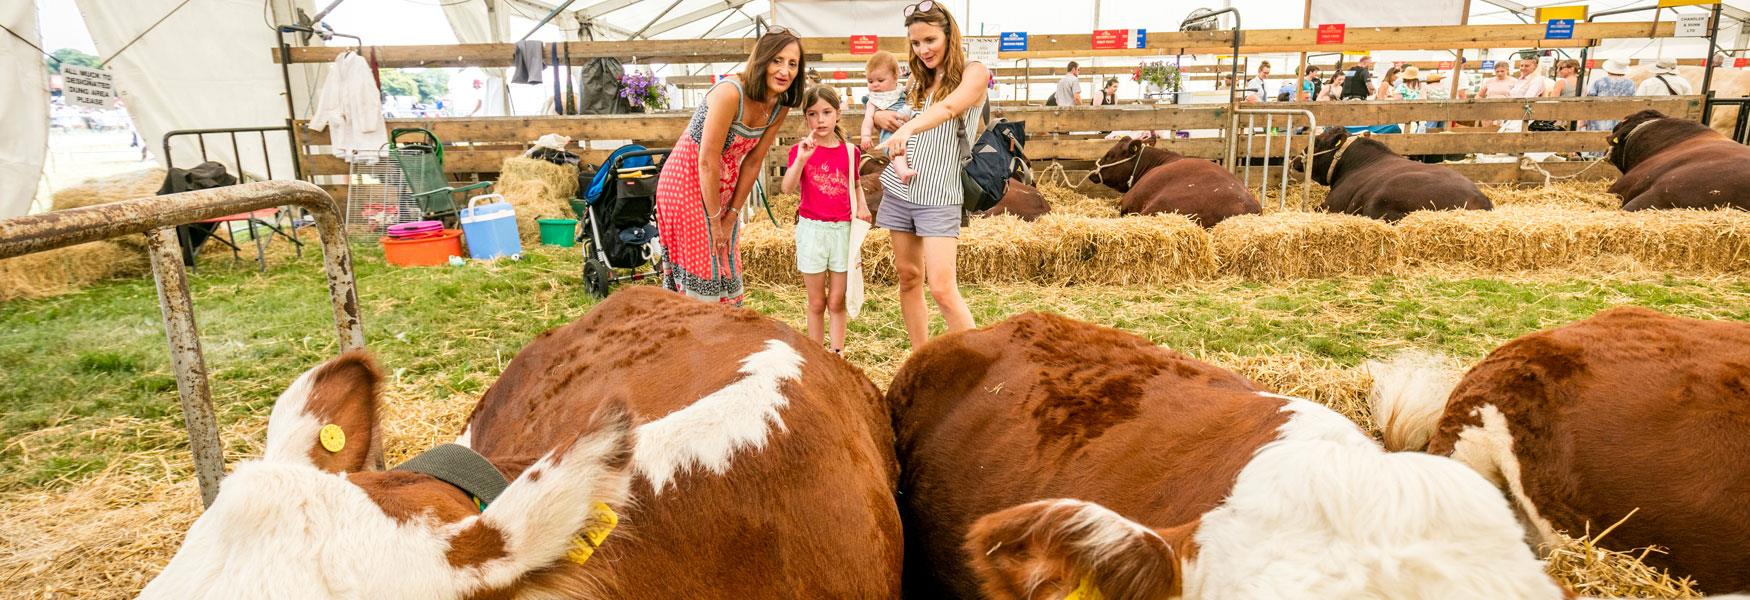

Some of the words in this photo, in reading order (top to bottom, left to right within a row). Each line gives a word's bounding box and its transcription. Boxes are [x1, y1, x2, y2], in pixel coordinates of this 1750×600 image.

[65, 76, 110, 89] DESIGNATED
[69, 86, 89, 95] DUNG
[91, 89, 110, 97] AREA
[76, 96, 104, 105] PLEASE
